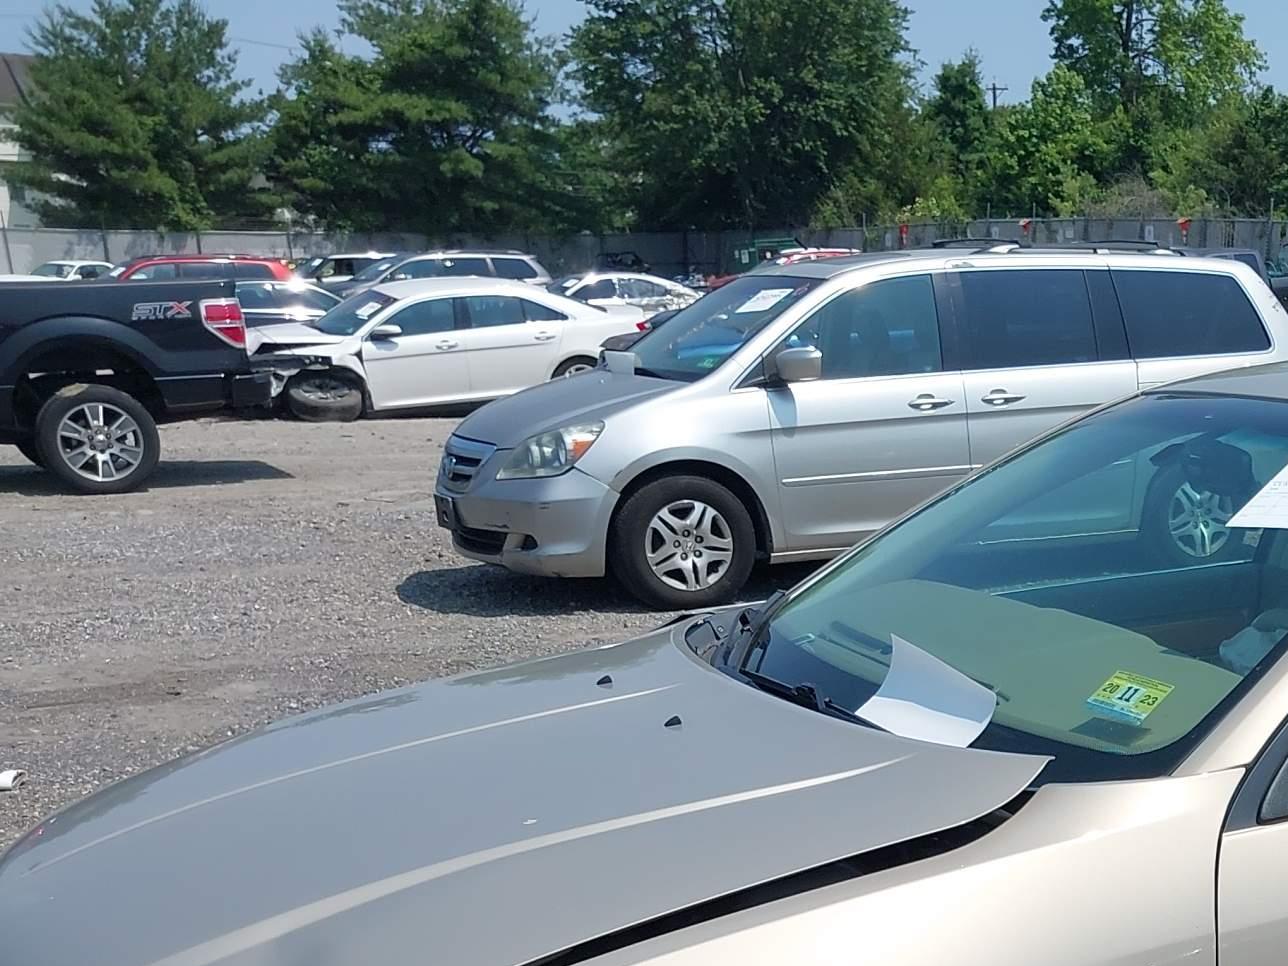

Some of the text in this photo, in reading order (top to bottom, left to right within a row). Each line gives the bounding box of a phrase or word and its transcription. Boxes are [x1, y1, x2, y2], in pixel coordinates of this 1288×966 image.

[134, 301, 193, 318] STX
[1102, 682, 1120, 694] 20
[1117, 686, 1140, 703] 11
[1139, 694, 1159, 706] 23
